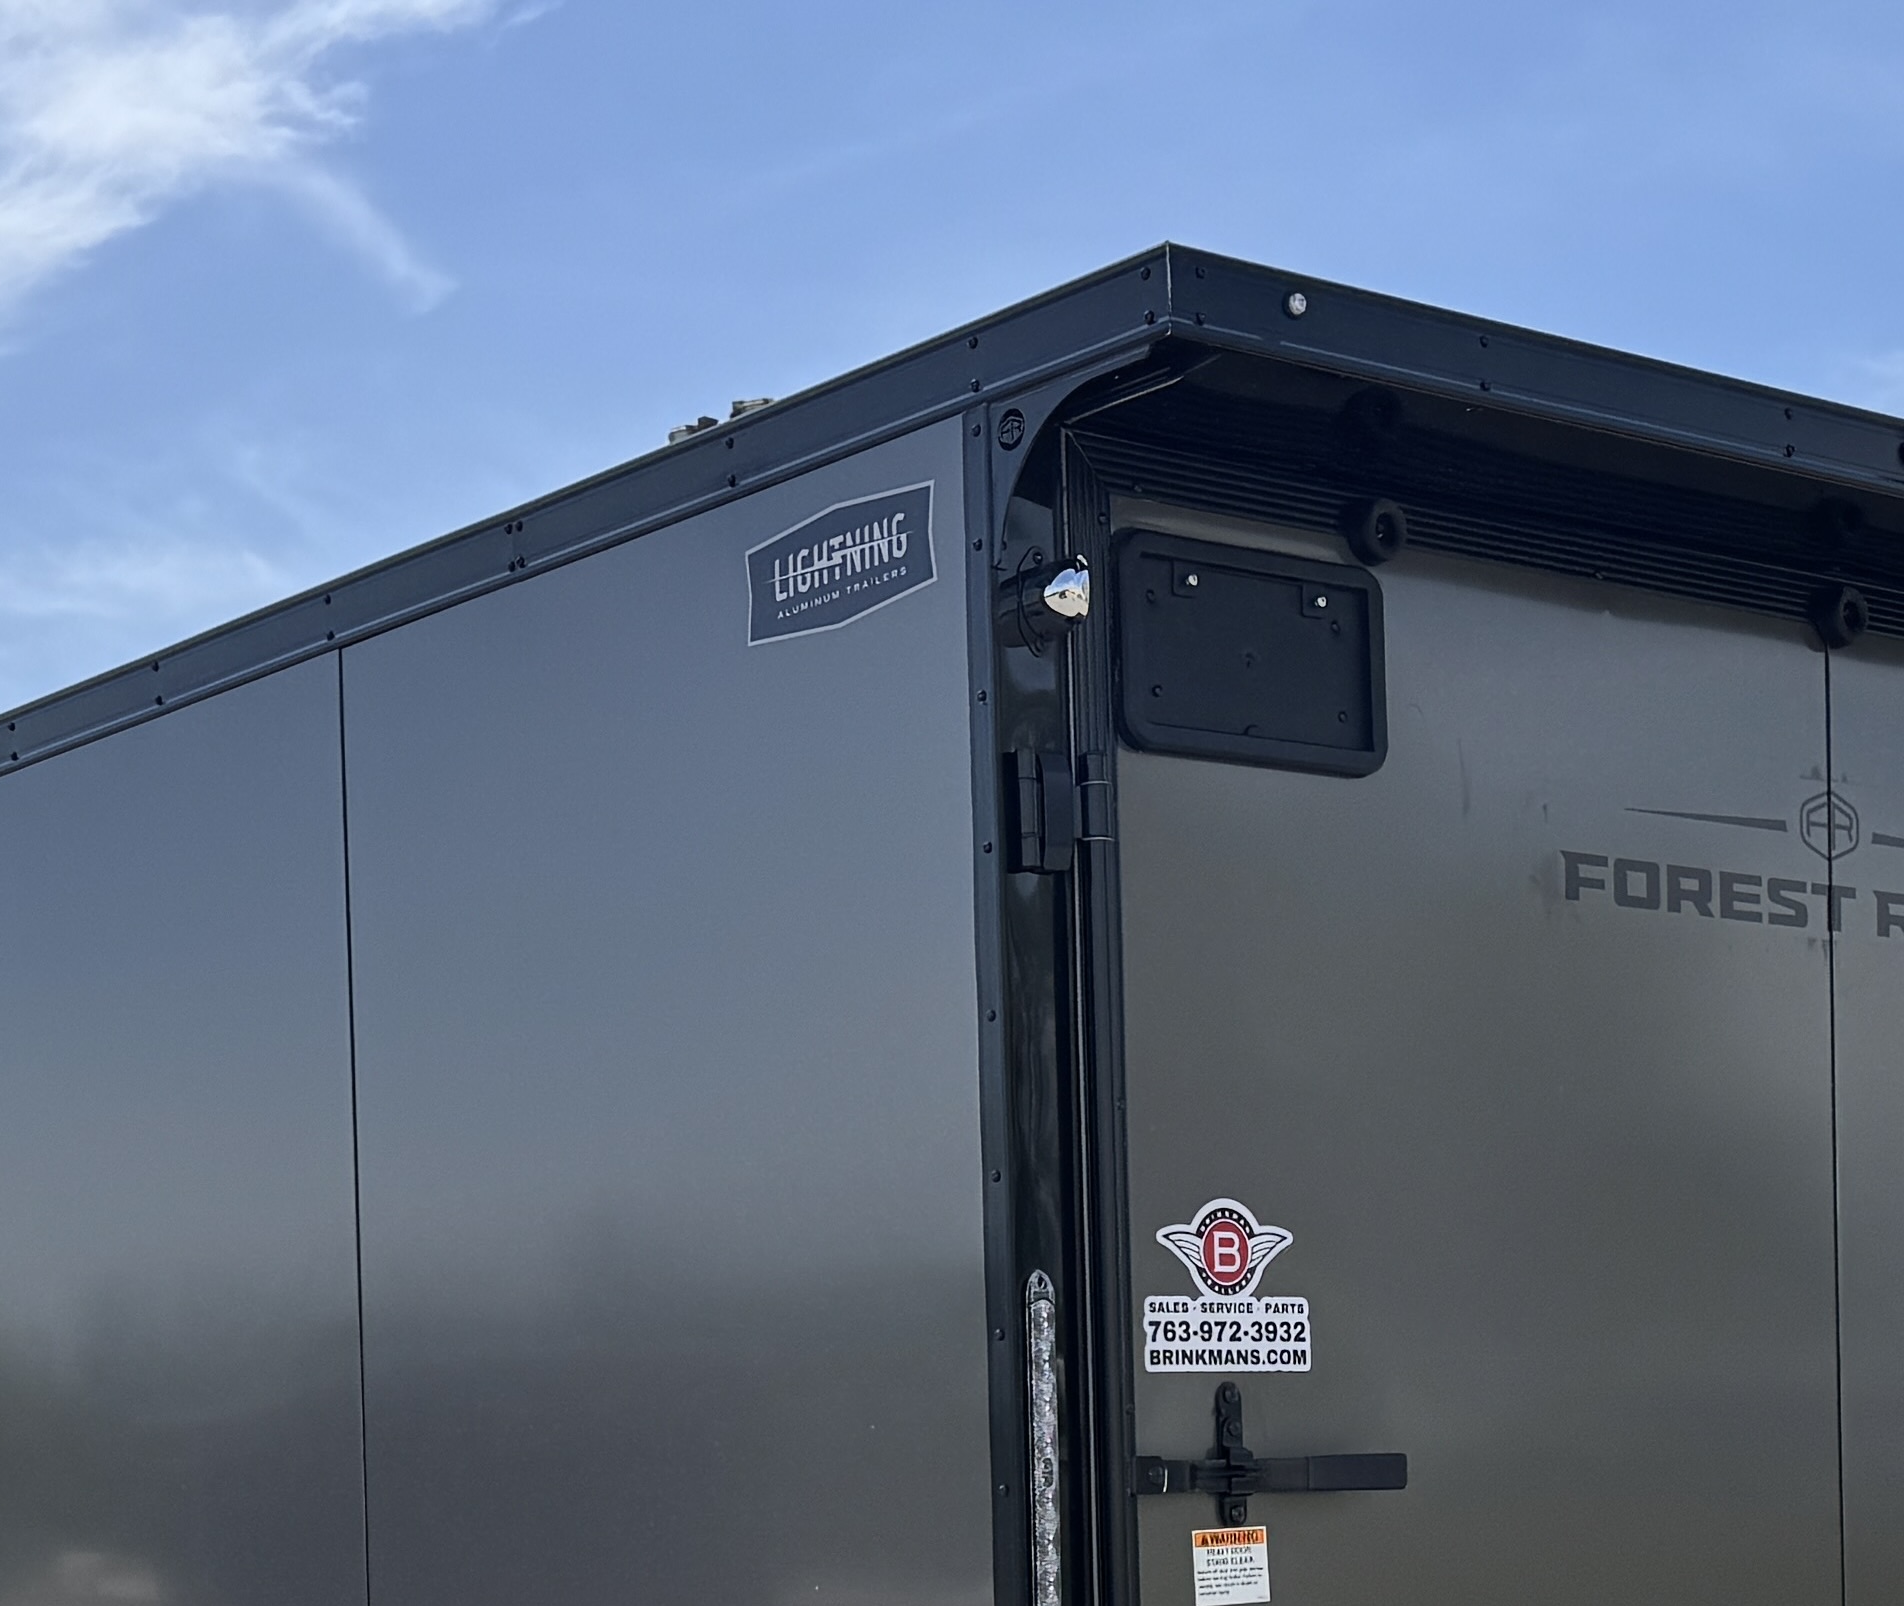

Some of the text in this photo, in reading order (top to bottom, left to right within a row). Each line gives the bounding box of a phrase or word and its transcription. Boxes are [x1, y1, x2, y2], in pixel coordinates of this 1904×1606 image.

[774, 512, 908, 602] LIGHTNING
[777, 566, 907, 619] ALUMINUM TRAILERS
[1559, 849, 1857, 933] FOREST
[1212, 1231, 1241, 1273] B
[1149, 1302, 1305, 1315] SALES SERVICE PARTS
[1149, 1349, 1307, 1366] BRINKMANS.COM
